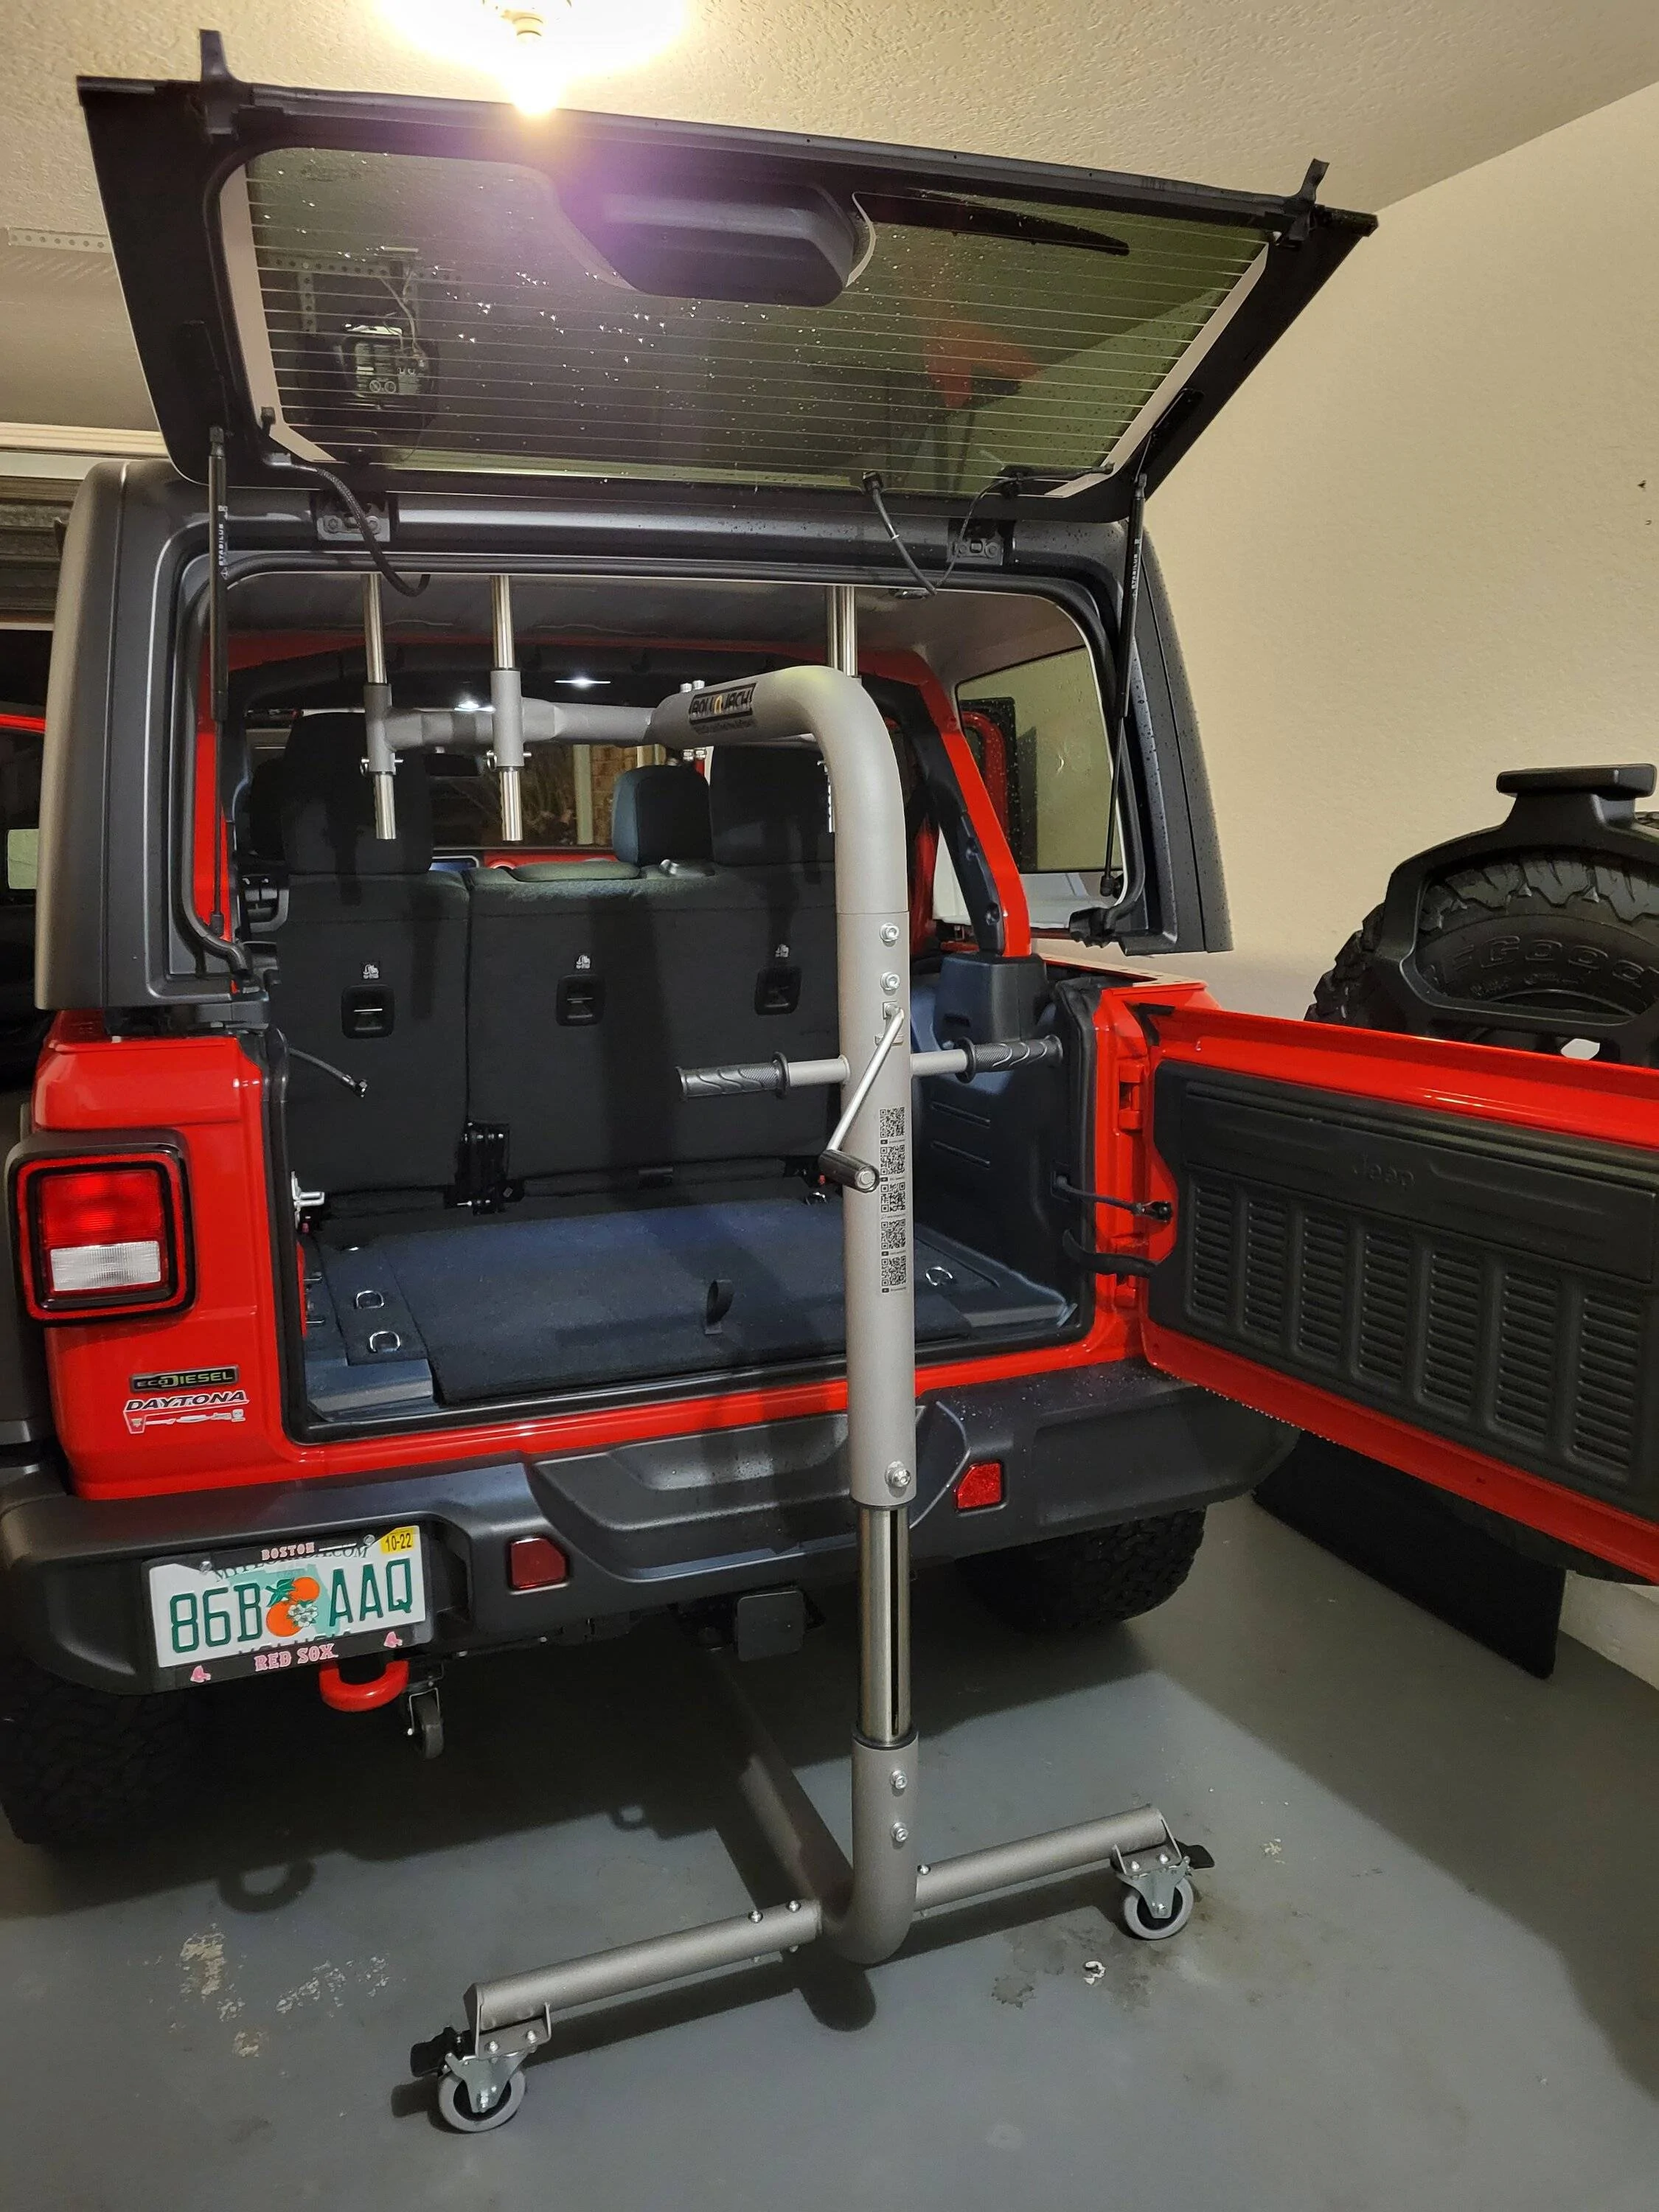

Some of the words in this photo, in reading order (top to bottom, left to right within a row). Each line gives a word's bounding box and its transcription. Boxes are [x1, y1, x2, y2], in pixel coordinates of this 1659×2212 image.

[126, 1391, 246, 1412] DAYTONA
[261, 1542, 316, 1561] BOSTON
[386, 1533, 411, 1552] 10-22
[170, 1582, 263, 1654] 86B
[329, 1558, 413, 1627] AAQ
[254, 1650, 292, 1672] RED
[297, 1643, 339, 1664] SOX
